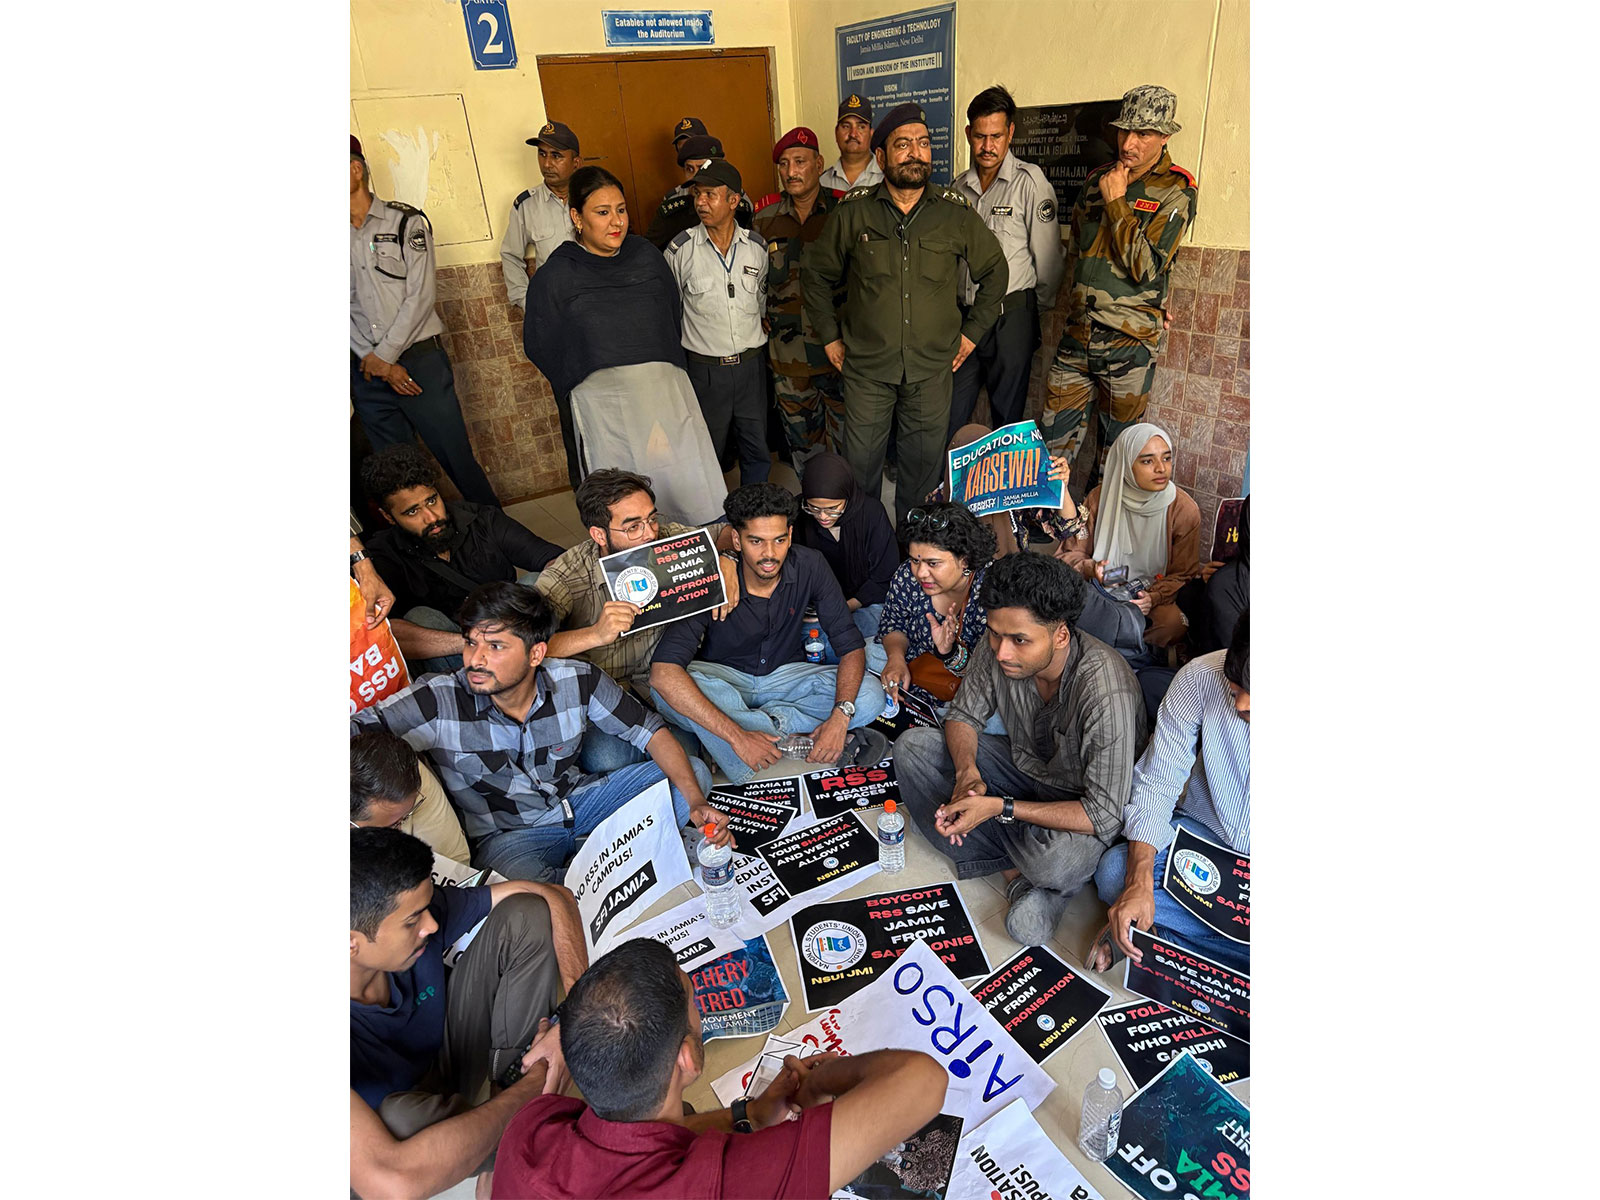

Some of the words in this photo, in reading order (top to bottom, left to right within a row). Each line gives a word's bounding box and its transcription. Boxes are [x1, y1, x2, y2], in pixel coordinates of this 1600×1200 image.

[615, 18, 644, 27] Eatables
[646, 18, 657, 27] not
[658, 18, 683, 27] allowed
[684, 17, 704, 27] inside
[846, 34, 864, 46] FACULTY
[864, 32, 871, 41] OF
[872, 26, 901, 40] ENGINEERING
[908, 18, 941, 32] TECHNOLOGY
[477, 12, 504, 54] 2
[637, 30, 649, 38] the
[650, 29, 685, 38] Auditorium
[860, 45, 871, 55] Jamia
[872, 43, 884, 52] Millia
[900, 38, 910, 46] New
[910, 35, 924, 44] Delhi
[853, 68, 866, 77] VISION
[866, 66, 875, 75] AND
[875, 64, 892, 74] MISSION
[893, 62, 900, 71] OF
[900, 61, 909, 70] THE
[910, 56, 935, 68] INSTITUTE
[884, 84, 898, 92] VISION
[1012, 147, 1026, 156] AMIA
[1028, 146, 1050, 156] MILLIA
[1052, 144, 1081, 156] ISLAMIA
[1050, 166, 1088, 178] MAHAJAN
[952, 432, 1027, 470] EDUCATION,
[964, 447, 1041, 502] KARSEWA!
[1002, 492, 1020, 501] JAMIA
[1020, 491, 1040, 499] MILLIA
[1003, 498, 1024, 507] ISLAMIA
[654, 535, 701, 555] BOYCOTT
[656, 553, 679, 566] RSS
[678, 544, 707, 558] SAVE
[667, 556, 704, 574] JAMIA
[672, 567, 704, 584] FROM
[660, 573, 720, 598] SAFFRONIS
[676, 588, 709, 604] ATION
[646, 602, 662, 612] JMI
[358, 656, 400, 702] RSS
[810, 770, 840, 780] SAY
[821, 770, 888, 791] RSS
[746, 782, 782, 790] JAMIA
[816, 792, 830, 800] IN
[832, 780, 899, 798] ACADEMIC
[836, 788, 886, 802] SPACES
[712, 795, 747, 808] JAMIA
[760, 805, 784, 816] NOT
[730, 808, 778, 824] SHAKHA
[746, 827, 758, 835] IT
[768, 844, 801, 859] YOUR
[800, 823, 852, 848] SHAKHA
[770, 832, 810, 850] JAMIA
[820, 816, 844, 830] NOT
[574, 884, 586, 906] NO
[585, 860, 600, 886] RSS
[598, 848, 610, 865] IN
[610, 814, 655, 854] JAMIA'S
[776, 852, 804, 867] AND
[804, 843, 824, 856] WE
[798, 846, 839, 868] ALLOW
[839, 840, 851, 850] IT
[592, 847, 634, 894] CAMPUS!
[736, 862, 768, 885] EDUC
[816, 868, 840, 882] NSUI
[840, 860, 860, 872] JMI
[746, 872, 776, 894] INST
[1172, 874, 1193, 896] NSUI
[1194, 894, 1213, 910] JMI
[594, 907, 608, 933] SFI
[608, 871, 650, 912] JAMIA
[760, 888, 786, 907] SFI
[866, 888, 944, 908] BOYCOTT
[868, 908, 904, 920] RSS
[904, 899, 950, 916] SAVE
[657, 930, 668, 940] IN
[669, 912, 706, 934] JAMIA'S
[806, 922, 841, 942] STUDENTS'
[842, 924, 862, 939] UNION
[884, 914, 945, 932] JAMIA
[891, 926, 946, 945] FROM
[676, 942, 708, 962] AMIA
[804, 944, 830, 970] NATIONAL
[848, 948, 864, 964] INDIA
[1152, 943, 1231, 980] BOYCOTT
[692, 960, 748, 990] CHERY
[811, 972, 845, 986] NSUI
[846, 966, 874, 978] JMI
[974, 969, 1015, 1002] OYCOTT
[1012, 955, 1034, 972] RSS
[1155, 954, 1198, 978] SAVE
[1200, 974, 1250, 1000] JAMI
[984, 991, 1008, 1012] AVE
[1006, 966, 1042, 996] JAMIA
[1180, 974, 1231, 1002] FROM
[696, 987, 746, 1014] TRED
[1002, 986, 1038, 1015] FROM
[1004, 972, 1076, 1032] FRONISATION
[710, 1018, 750, 1030] ISLAMIA
[1100, 1012, 1127, 1026] NO
[1172, 1000, 1202, 1016] NSUI
[1202, 1015, 1228, 1029] JMI
[1038, 1030, 1062, 1050] NSUI
[1060, 1016, 1078, 1033] JMI
[1126, 1022, 1163, 1038] FOR
[1162, 1014, 1198, 1030] THO
[1127, 1034, 1172, 1053] WHO
[1156, 1038, 1228, 1063] GANDHI
[1218, 1071, 1240, 1083] JMI
[1118, 1143, 1178, 1192] OFF
